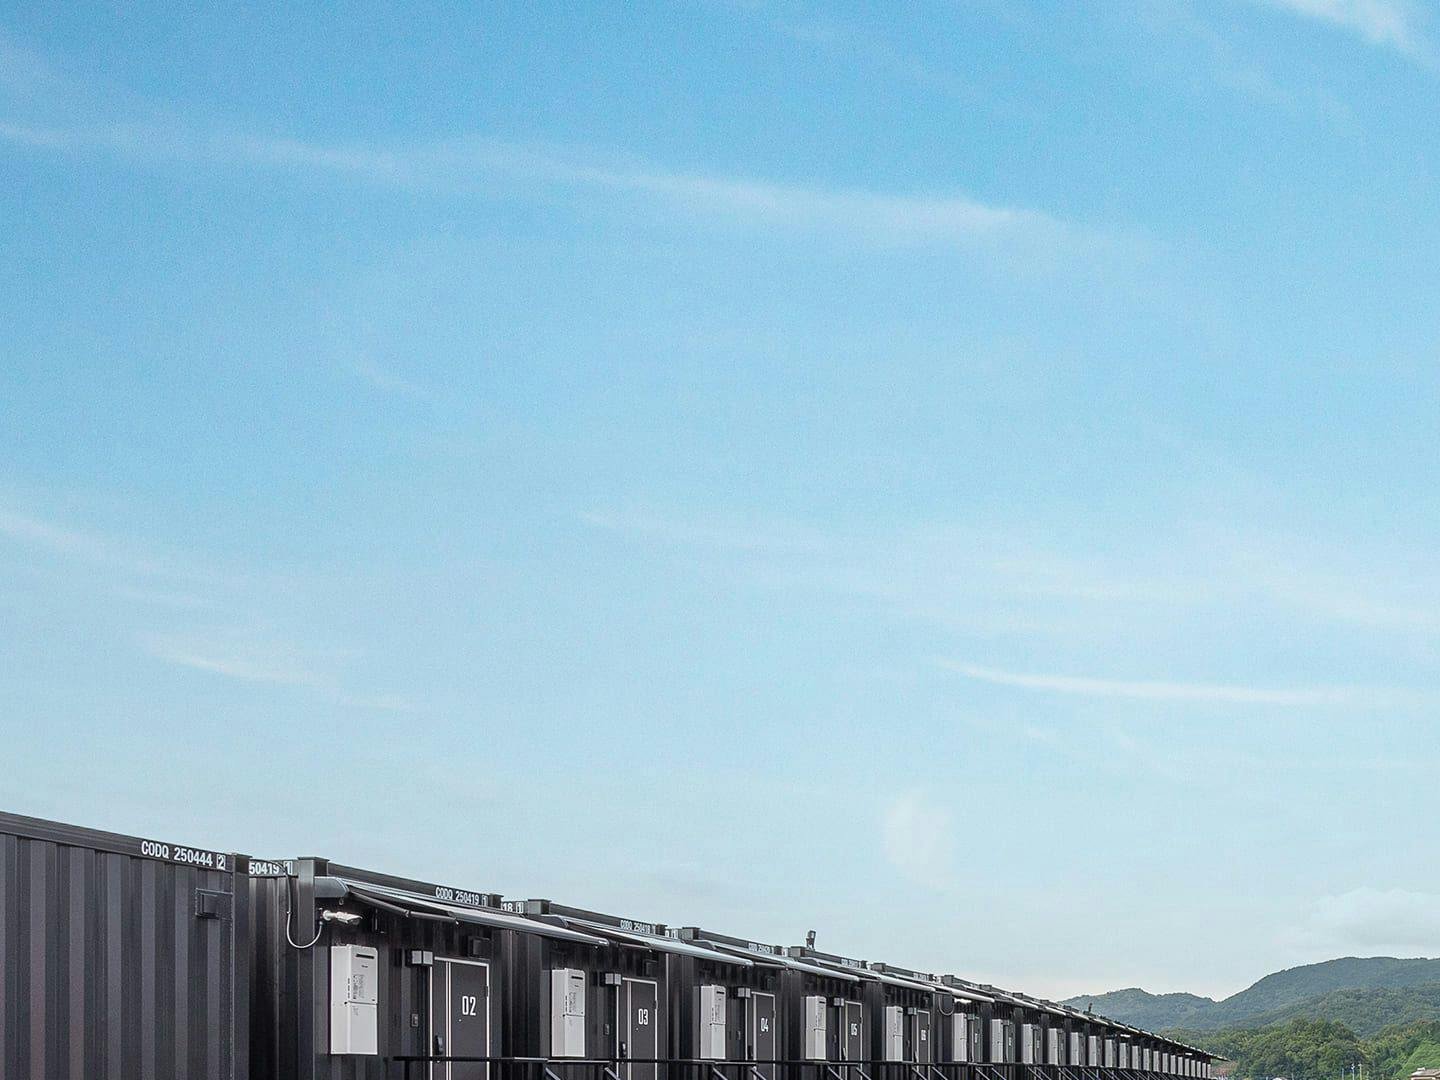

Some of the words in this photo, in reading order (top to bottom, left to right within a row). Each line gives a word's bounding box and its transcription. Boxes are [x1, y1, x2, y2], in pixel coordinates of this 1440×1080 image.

[141, 840, 170, 859] CODQ
[173, 846, 213, 867] 250444
[462, 995, 477, 1016] 02
[638, 1008, 649, 1025] 03
[759, 1017, 769, 1032] 04
